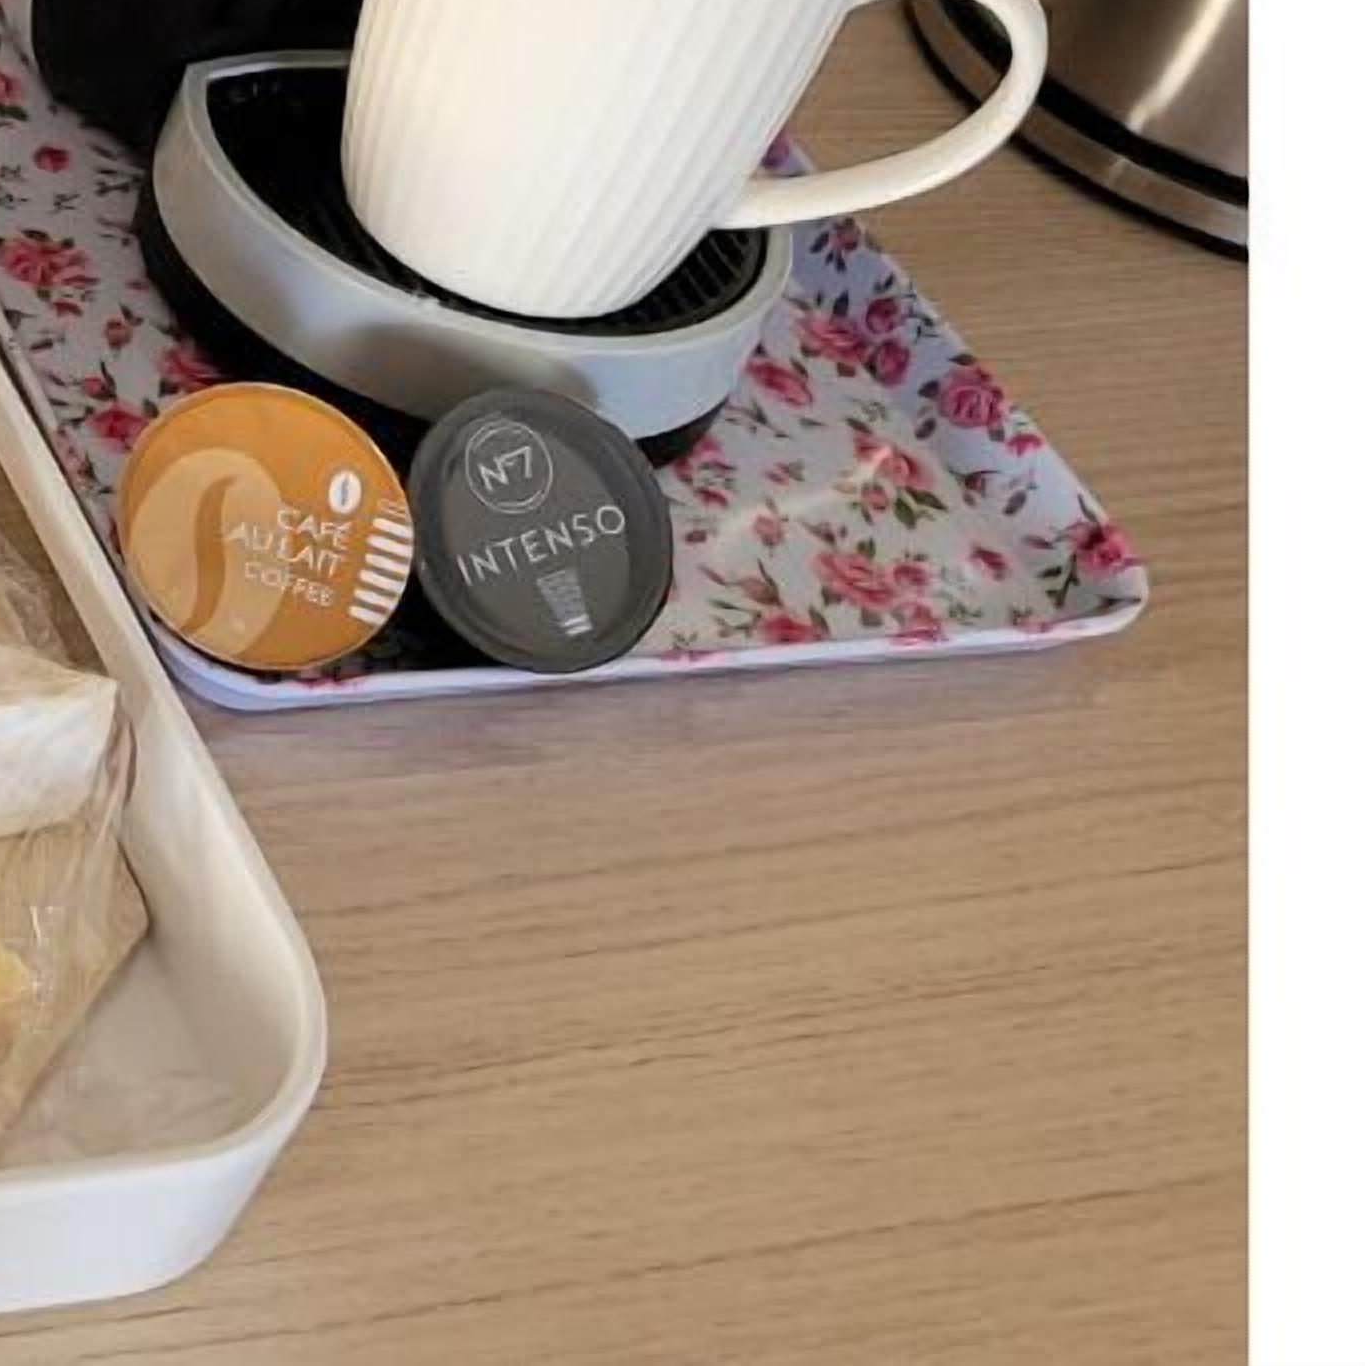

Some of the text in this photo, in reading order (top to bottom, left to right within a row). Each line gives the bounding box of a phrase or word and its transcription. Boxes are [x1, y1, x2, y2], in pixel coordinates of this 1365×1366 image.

[225, 522, 345, 579] AU LAIT
[277, 509, 352, 550] CAFÉ
[457, 505, 624, 586] INTENSO
[245, 562, 334, 607] COFFEE
